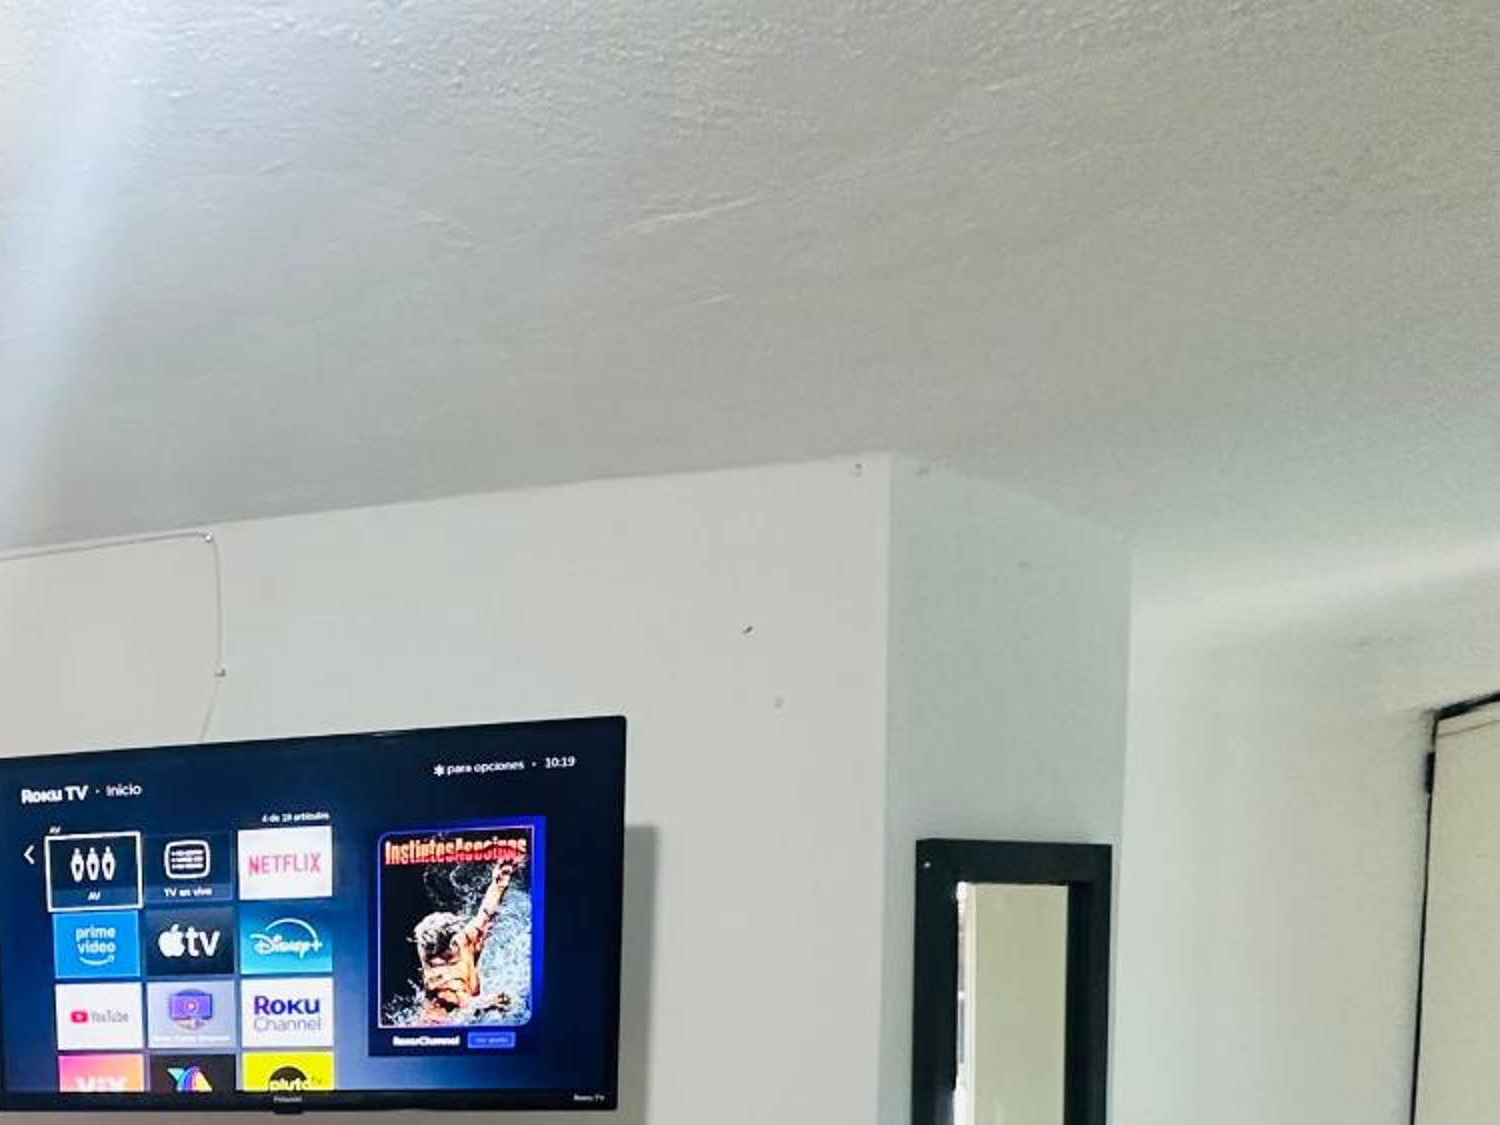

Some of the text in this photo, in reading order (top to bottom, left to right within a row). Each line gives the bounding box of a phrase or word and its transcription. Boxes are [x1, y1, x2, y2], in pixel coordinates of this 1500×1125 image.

[446, 761, 525, 776] para opciones
[545, 756, 576, 769] 10:19
[64, 786, 89, 801] TV
[106, 783, 143, 797] Inicio
[248, 853, 321, 876] NETFLIX
[88, 891, 101, 901] AV
[163, 885, 213, 897] TV en vivo
[75, 924, 117, 942] prime
[77, 940, 117, 954] video
[185, 926, 221, 957] tv
[90, 1010, 130, 1024] YouTube
[253, 1016, 322, 1032] Channel
